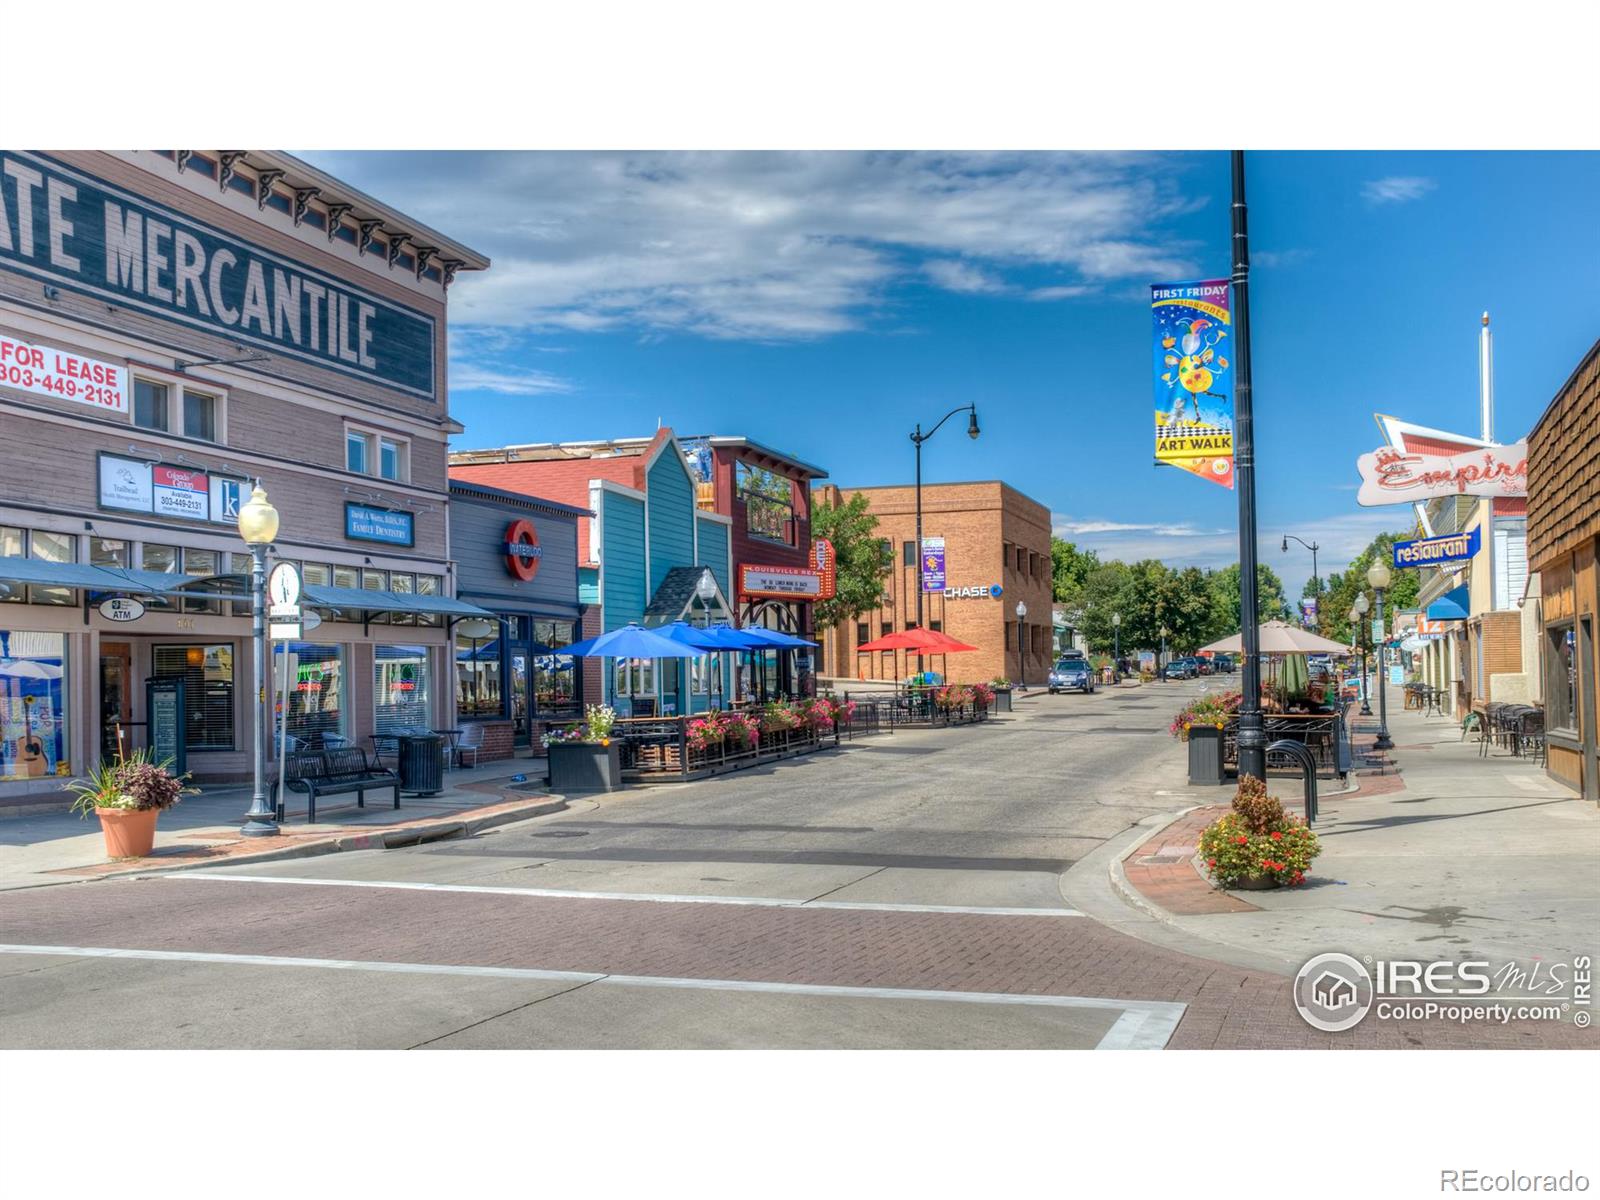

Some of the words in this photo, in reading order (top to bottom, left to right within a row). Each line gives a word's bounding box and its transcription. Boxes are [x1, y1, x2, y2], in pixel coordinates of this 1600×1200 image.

[104, 200, 376, 370] MERCANTILE
[1153, 288, 1185, 299] FIRST
[1187, 285, 1228, 296] FRIDAY
[1, 340, 45, 370] FOR
[55, 353, 118, 388] LEASE
[0, 362, 122, 409] 303-449-2131
[1158, 439, 1186, 451] ART
[1190, 437, 1231, 449] WALK
[161, 496, 202, 510] 303-449-2131
[510, 543, 543, 558] WATERLOO
[1397, 533, 1472, 563] restaurant
[816, 541, 825, 570] REX
[749, 566, 799, 576] LOUISVILLE
[944, 586, 988, 598] CHASE
[113, 611, 131, 619] ATM
